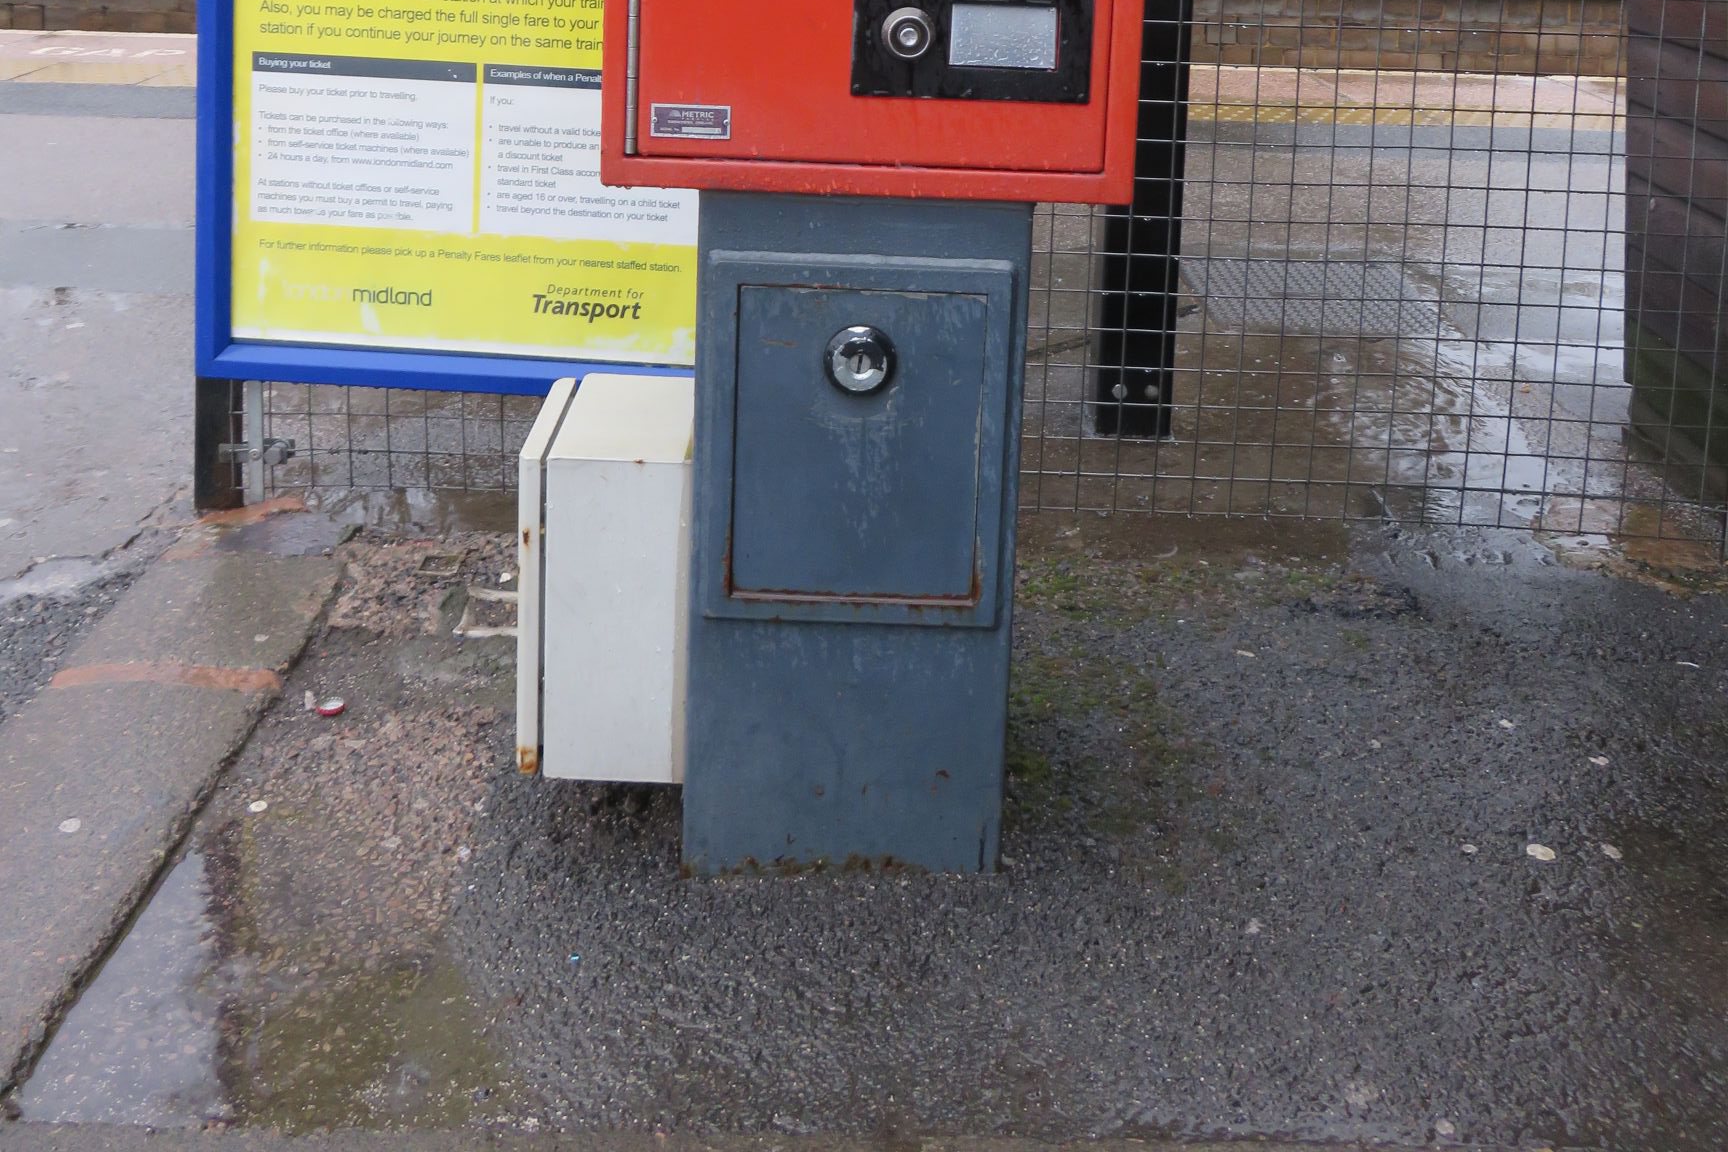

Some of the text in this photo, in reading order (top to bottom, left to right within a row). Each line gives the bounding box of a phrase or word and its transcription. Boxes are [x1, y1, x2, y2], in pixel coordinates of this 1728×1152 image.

[260, 0, 291, 17] Also,
[296, 5, 320, 18] you
[324, 6, 353, 20] may
[357, 4, 373, 18] be
[377, 6, 431, 24] charged
[435, 8, 455, 22] the
[459, 10, 478, 23] full
[482, 11, 520, 28] single
[524, 13, 549, 26] fare
[569, 18, 599, 32] your
[259, 21, 302, 36] station
[306, 23, 313, 36] if
[317, 27, 341, 40] you
[345, 25, 400, 40] continue
[405, 31, 434, 45] your
[437, 30, 486, 47] journey
[510, 33, 531, 47] the
[535, 37, 572, 49] same
[29, 46, 187, 58] GAP
[258, 57, 330, 69] Buying your ticket
[490, 69, 531, 80] Examples
[542, 71, 566, 80] when
[259, 238, 274, 250] For
[276, 239, 306, 251] further
[308, 241, 358, 254] information
[361, 244, 392, 258] please
[394, 246, 412, 260] pick
[437, 248, 472, 263] Penalty
[474, 250, 501, 262] Fares
[503, 251, 530, 264] leaflet
[533, 253, 554, 265] from
[556, 257, 576, 268] your
[578, 257, 614, 268] nearest
[616, 258, 647, 270] staffed
[649, 259, 682, 272] station.
[352, 285, 432, 306] midland
[547, 284, 643, 300] Department for
[533, 294, 640, 324] Transport
